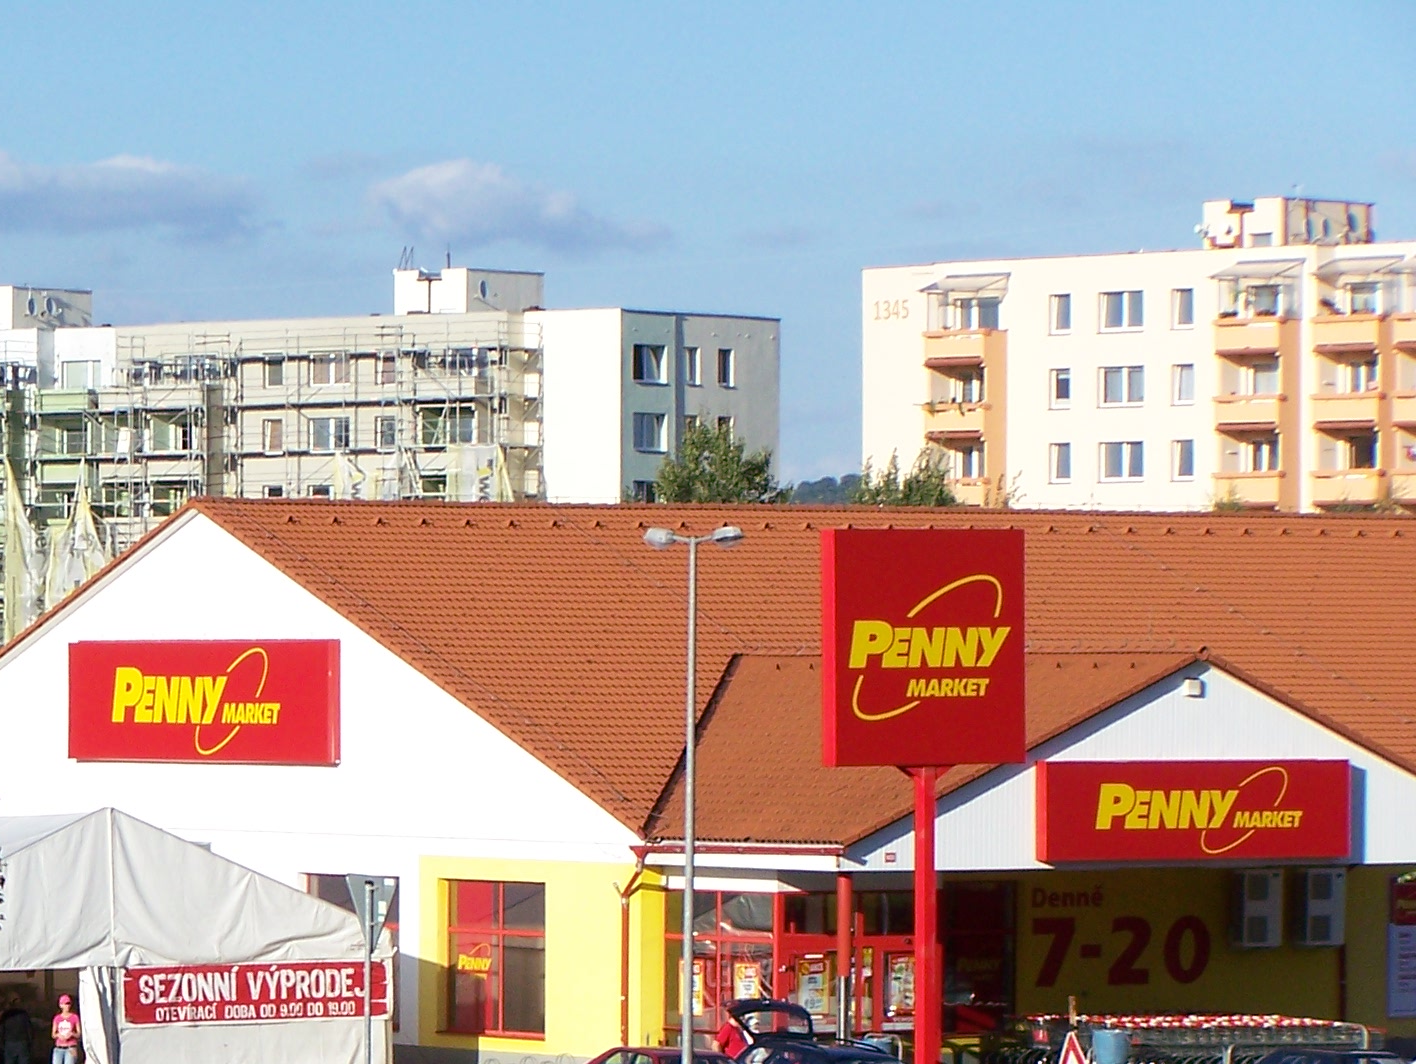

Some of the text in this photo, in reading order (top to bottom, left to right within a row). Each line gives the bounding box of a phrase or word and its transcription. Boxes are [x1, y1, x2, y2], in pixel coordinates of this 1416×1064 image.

[873, 299, 910, 321] 1345
[848, 619, 1012, 669] PENNY
[111, 666, 281, 725] PENNY MARKET
[906, 677, 990, 698] MARKET
[1095, 782, 1303, 830] PENNY MARKET
[1031, 885, 1104, 908] Denně
[457, 953, 492, 971] PENNY
[138, 966, 240, 1005] SEZONNÍ
[155, 1003, 217, 1022] OTEVÍRACÍ
[224, 1004, 257, 1020] DOBA
[260, 1004, 275, 1018] OD
[307, 1002, 324, 1016] DO
